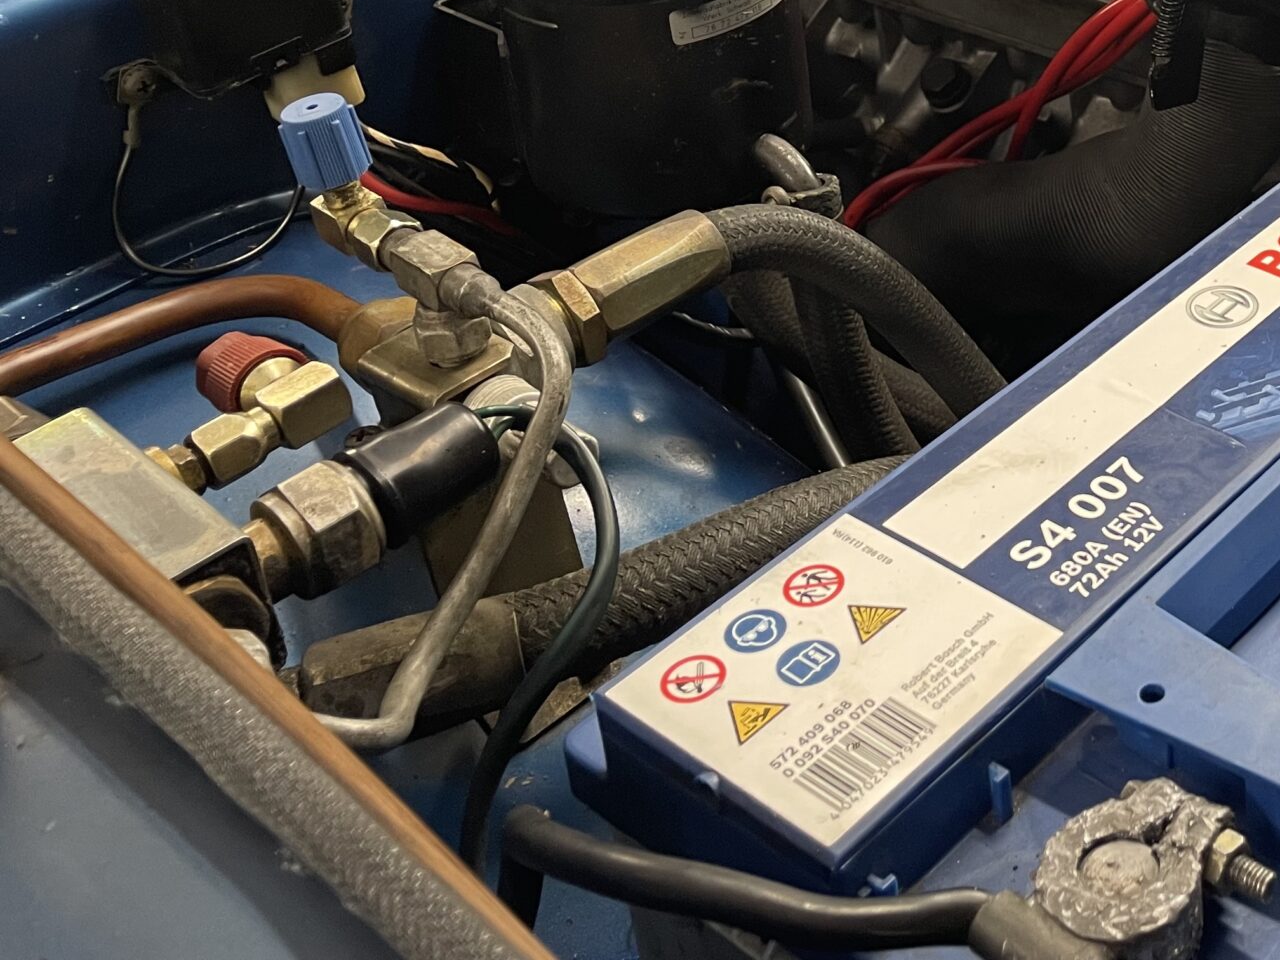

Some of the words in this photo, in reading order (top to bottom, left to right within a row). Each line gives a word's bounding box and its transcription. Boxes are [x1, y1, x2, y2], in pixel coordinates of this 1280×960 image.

[1009, 519, 1077, 570] S4
[1068, 456, 1144, 519] 007
[1049, 541, 1109, 586] 680A
[1101, 502, 1152, 540] (EN)
[1068, 552, 1129, 598] 72Ah
[1123, 515, 1164, 552] 12V
[901, 661, 937, 692] Robert
[934, 638, 965, 663] Bosch
[963, 611, 994, 638] GmbH
[920, 677, 951, 705] 76227
[930, 667, 948, 684] der
[931, 672, 976, 710] Germany
[769, 747, 799, 771] 572
[798, 724, 824, 748] 409
[824, 700, 853, 724] 068
[782, 768, 795, 779] 0
[794, 744, 824, 769] 092
[821, 721, 850, 745] S40
[849, 698, 877, 721] 070
